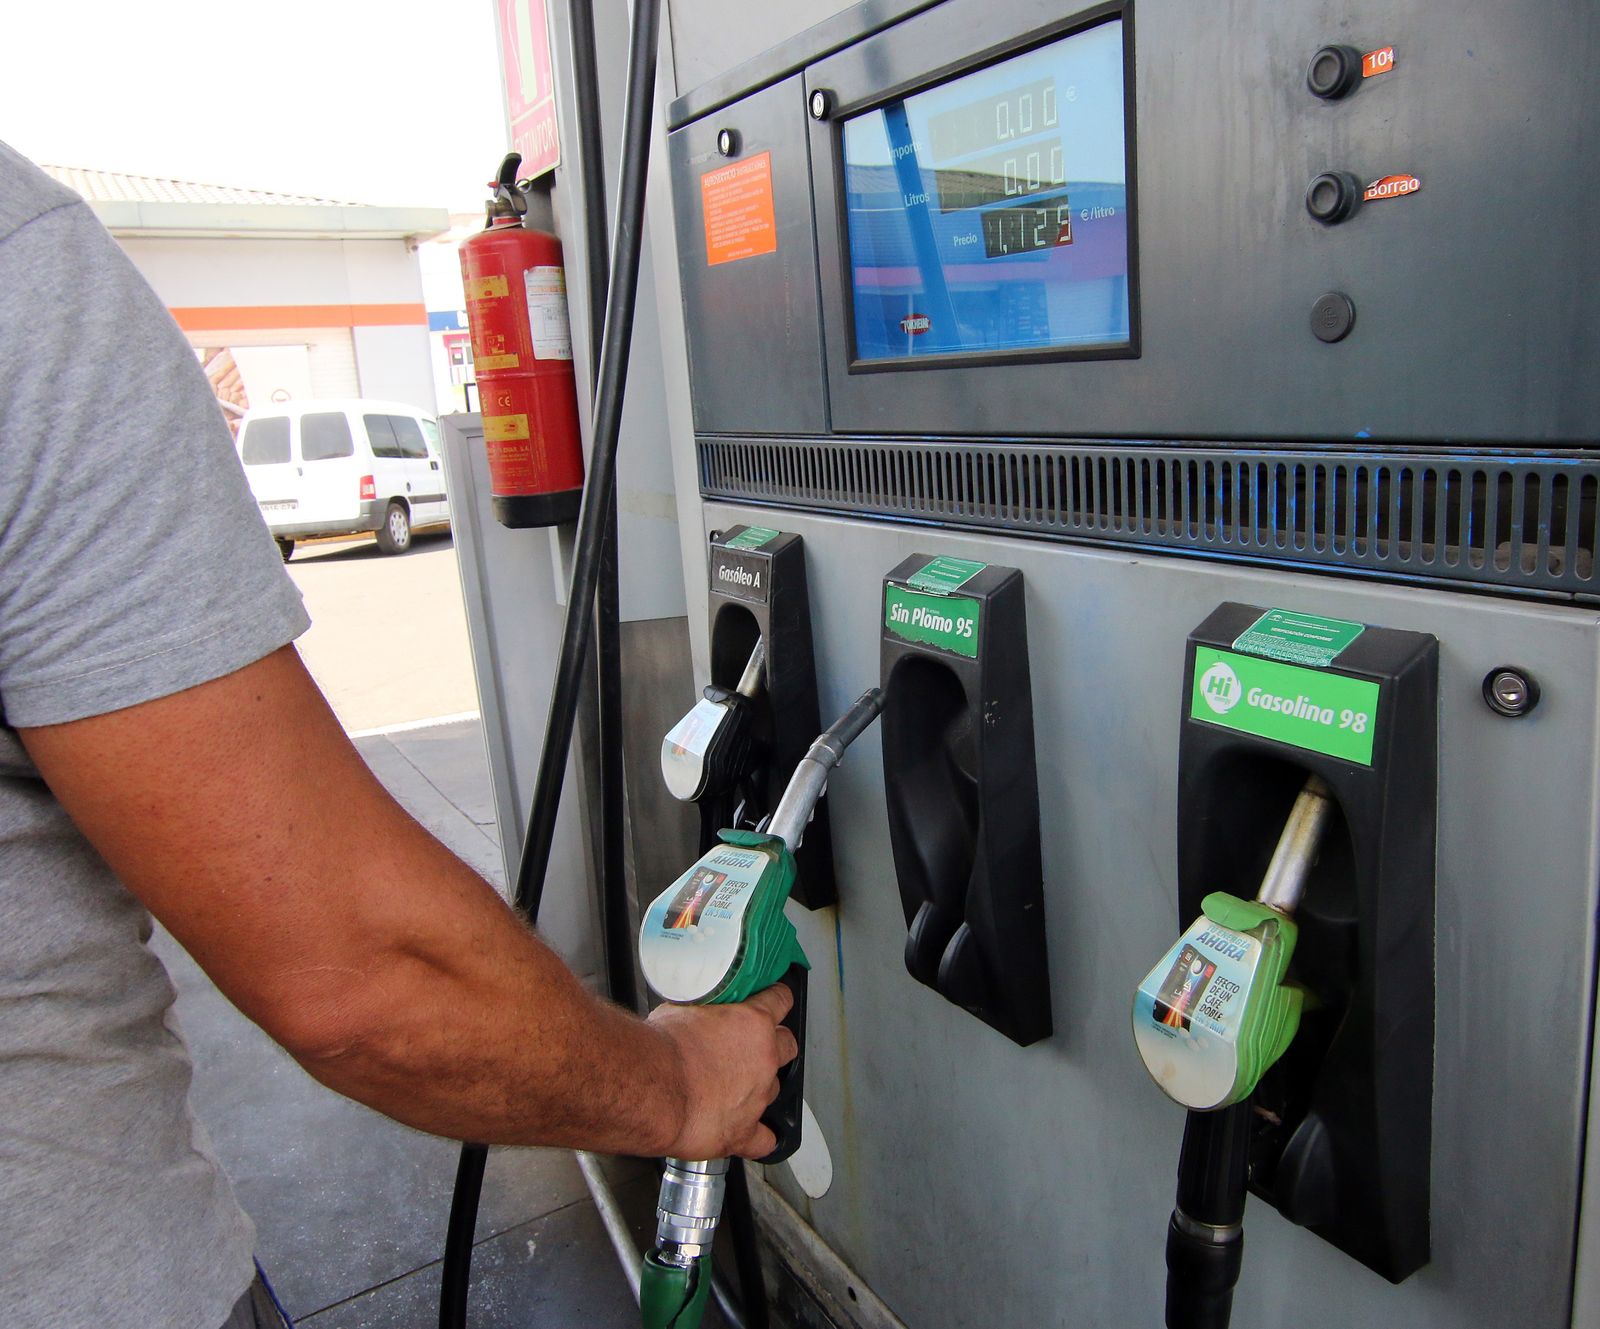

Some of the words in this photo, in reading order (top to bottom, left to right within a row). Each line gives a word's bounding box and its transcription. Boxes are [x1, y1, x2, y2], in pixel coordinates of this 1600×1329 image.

[904, 191, 930, 207] Litros
[953, 234, 978, 247] Precio
[718, 565, 752, 586] Gasóleo
[753, 571, 760, 588] A
[890, 603, 910, 624] Sin
[911, 607, 953, 633] Plomo
[956, 617, 974, 638] 95
[1207, 675, 1232, 697] Hi
[1247, 687, 1334, 726] Gasolina
[1339, 709, 1368, 734] 98
[710, 855, 755, 869] AHORA
[725, 879, 749, 889] EFECTO
[1195, 930, 1246, 962] AHORA
[1209, 984, 1221, 996] DE
[1219, 990, 1233, 1003] UN
[1214, 975, 1240, 994] EFECTO
[1199, 1003, 1224, 1022] DOBLE
